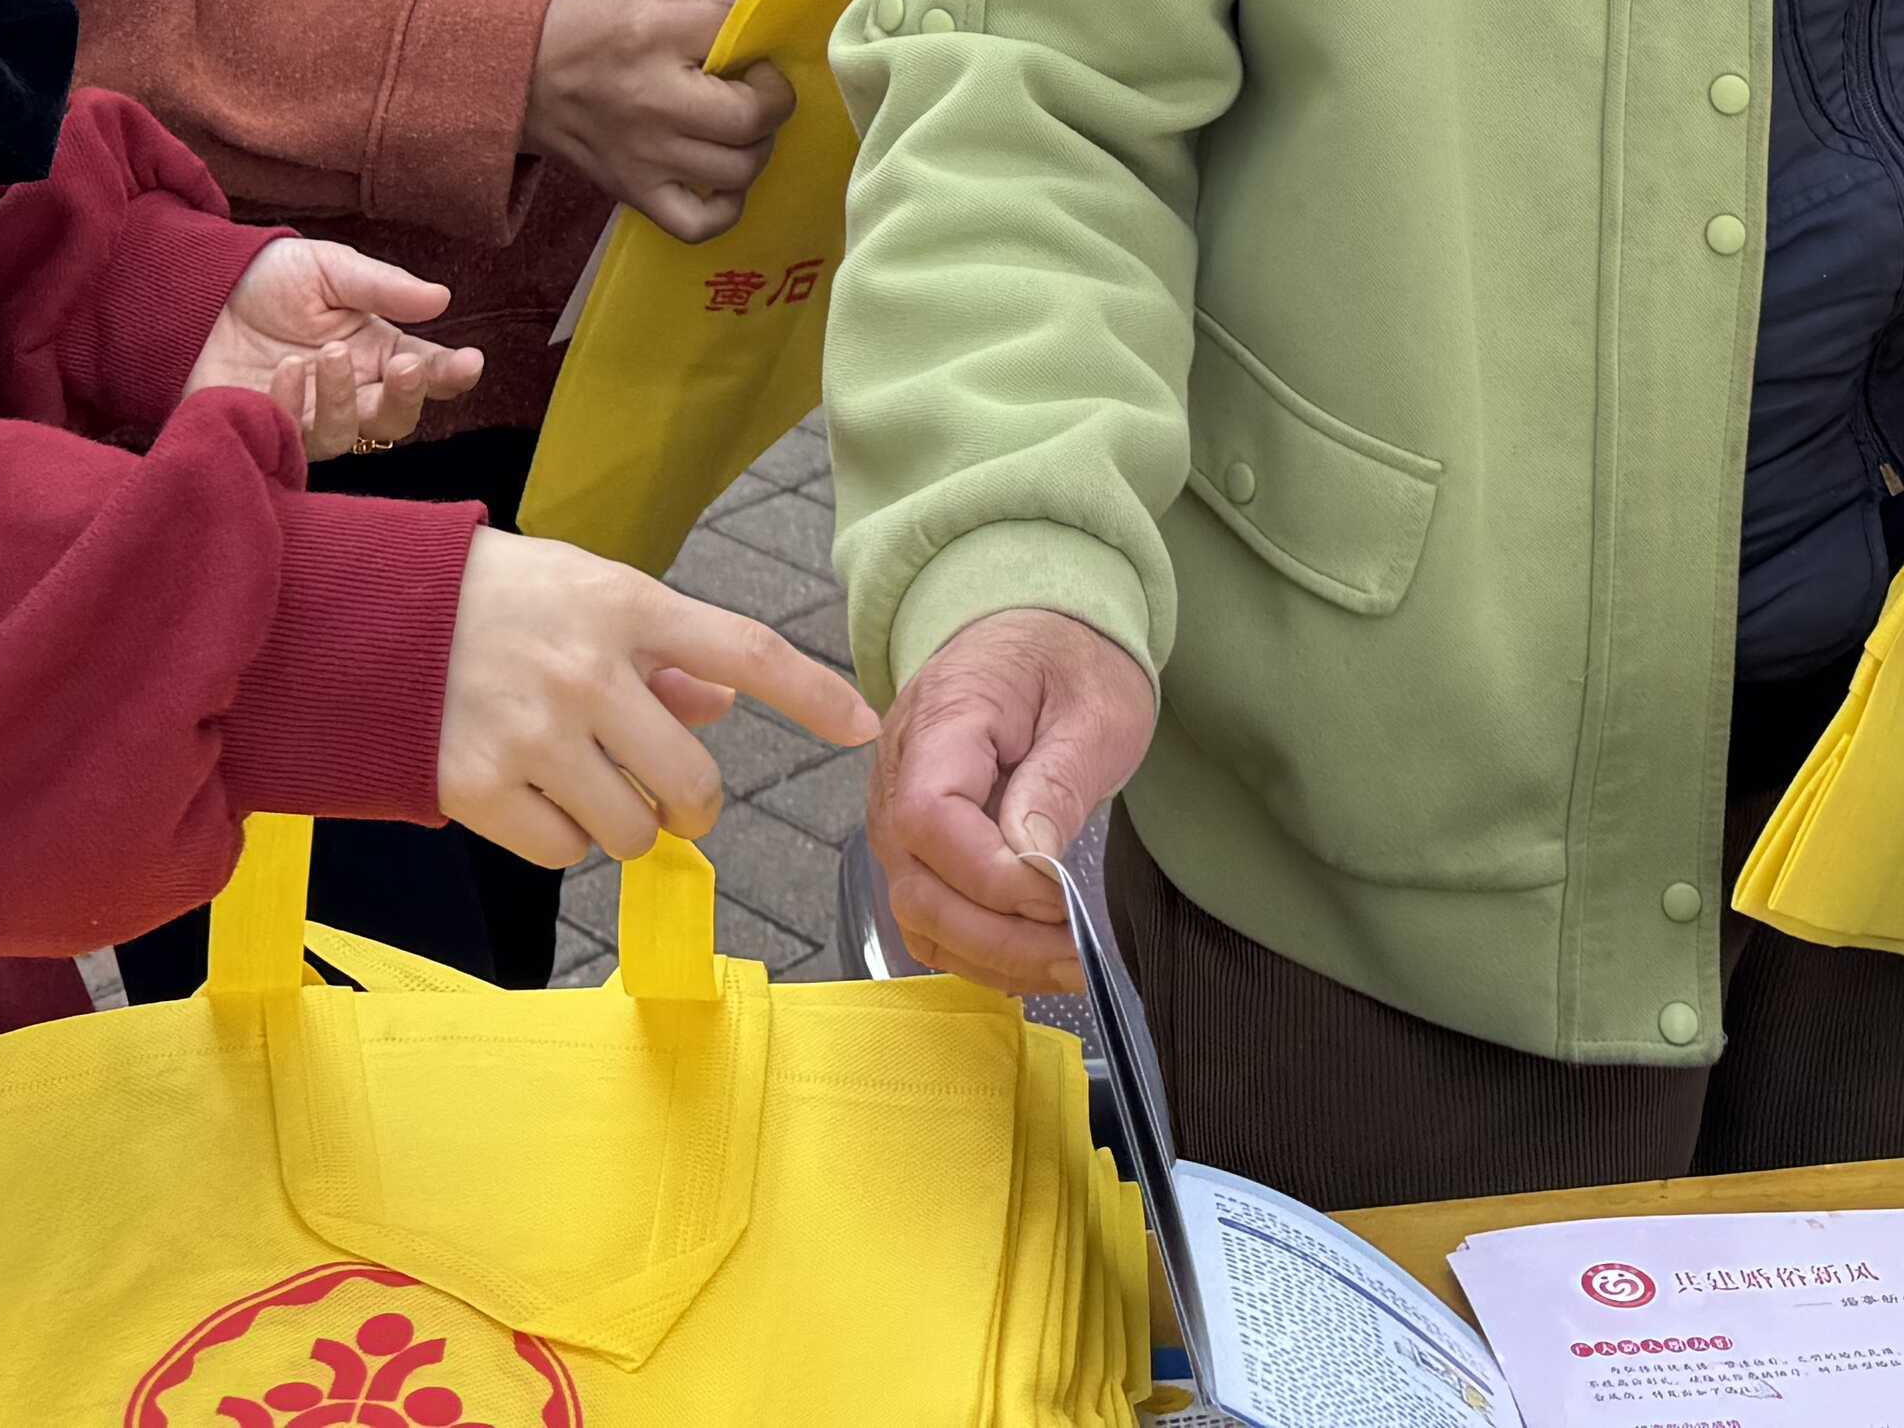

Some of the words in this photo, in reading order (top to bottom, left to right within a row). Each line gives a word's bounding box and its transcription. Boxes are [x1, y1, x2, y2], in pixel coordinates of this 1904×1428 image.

[704, 257, 826, 315] 黄石
[1674, 1261, 1880, 1294] 共建婚俗新风
